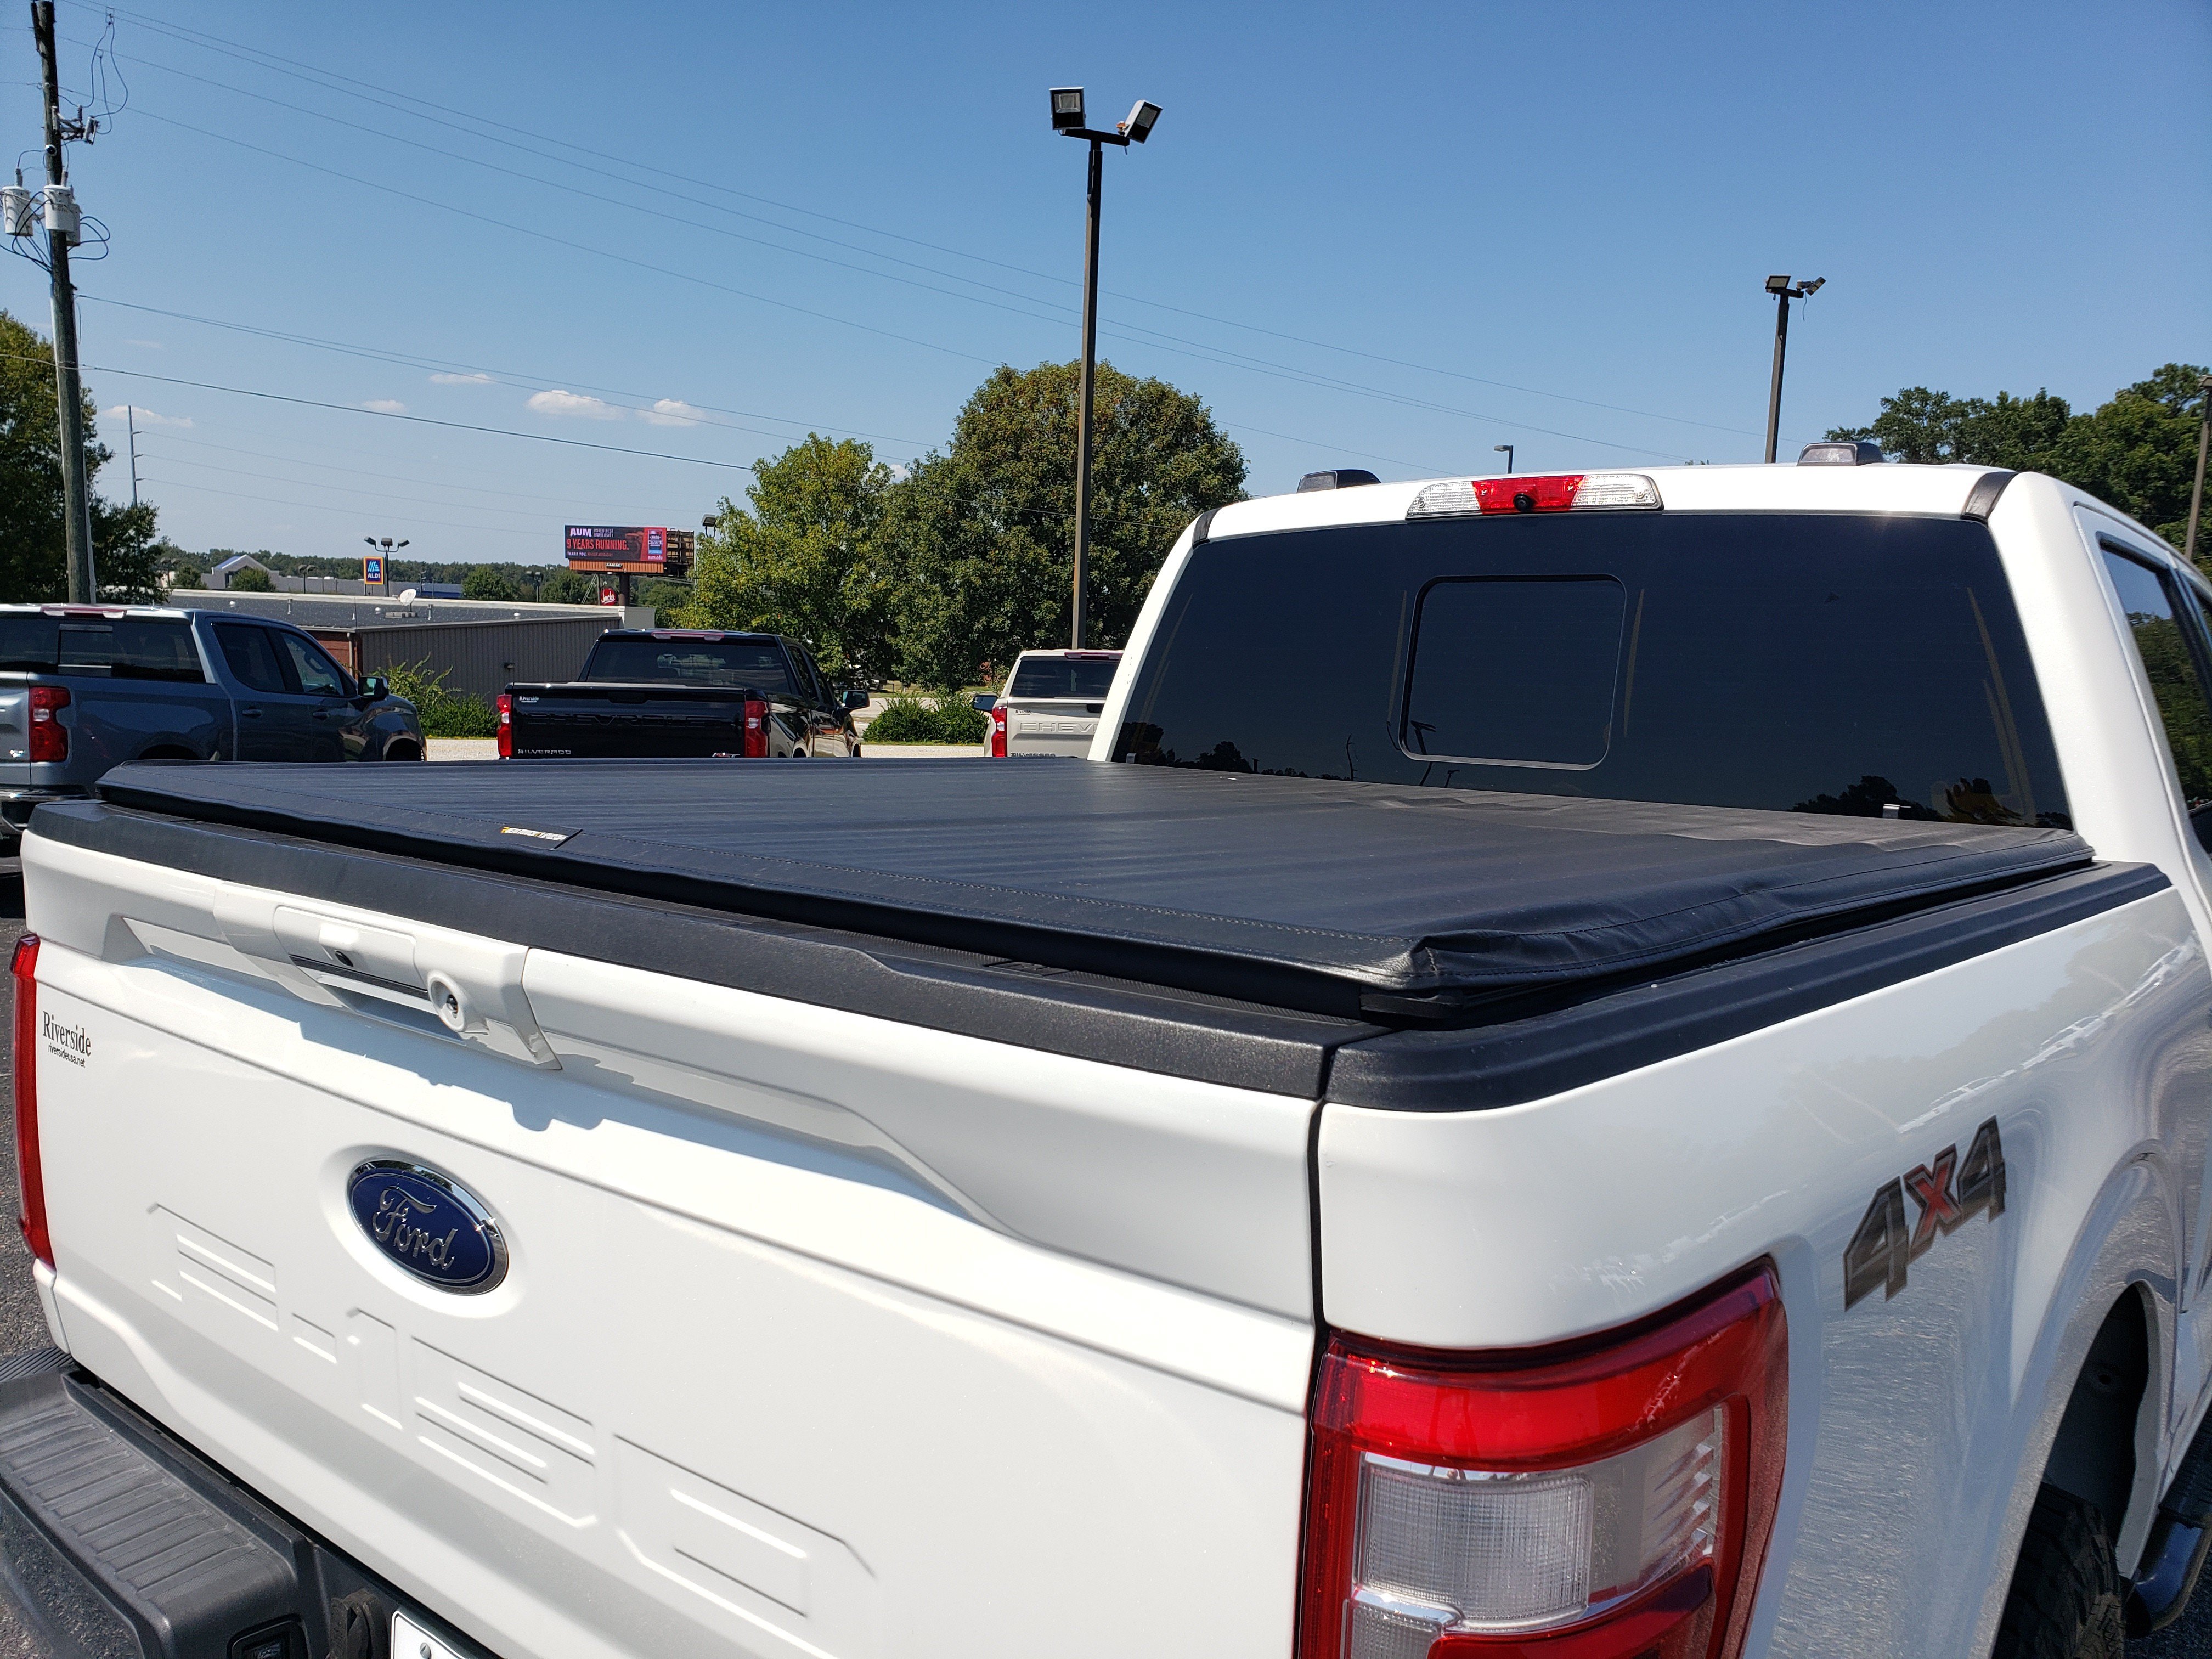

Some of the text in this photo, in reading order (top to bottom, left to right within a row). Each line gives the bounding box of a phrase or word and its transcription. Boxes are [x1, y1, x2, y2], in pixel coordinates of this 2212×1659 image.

[570, 528, 592, 537] AUM
[567, 538, 629, 551] 9 YEARS RUNNING.
[601, 590, 616, 602] Jack's
[42, 1011, 92, 1057] Riverside
[48, 1042, 86, 1069] riversideusa.net
[371, 1184, 459, 1271] Ford
